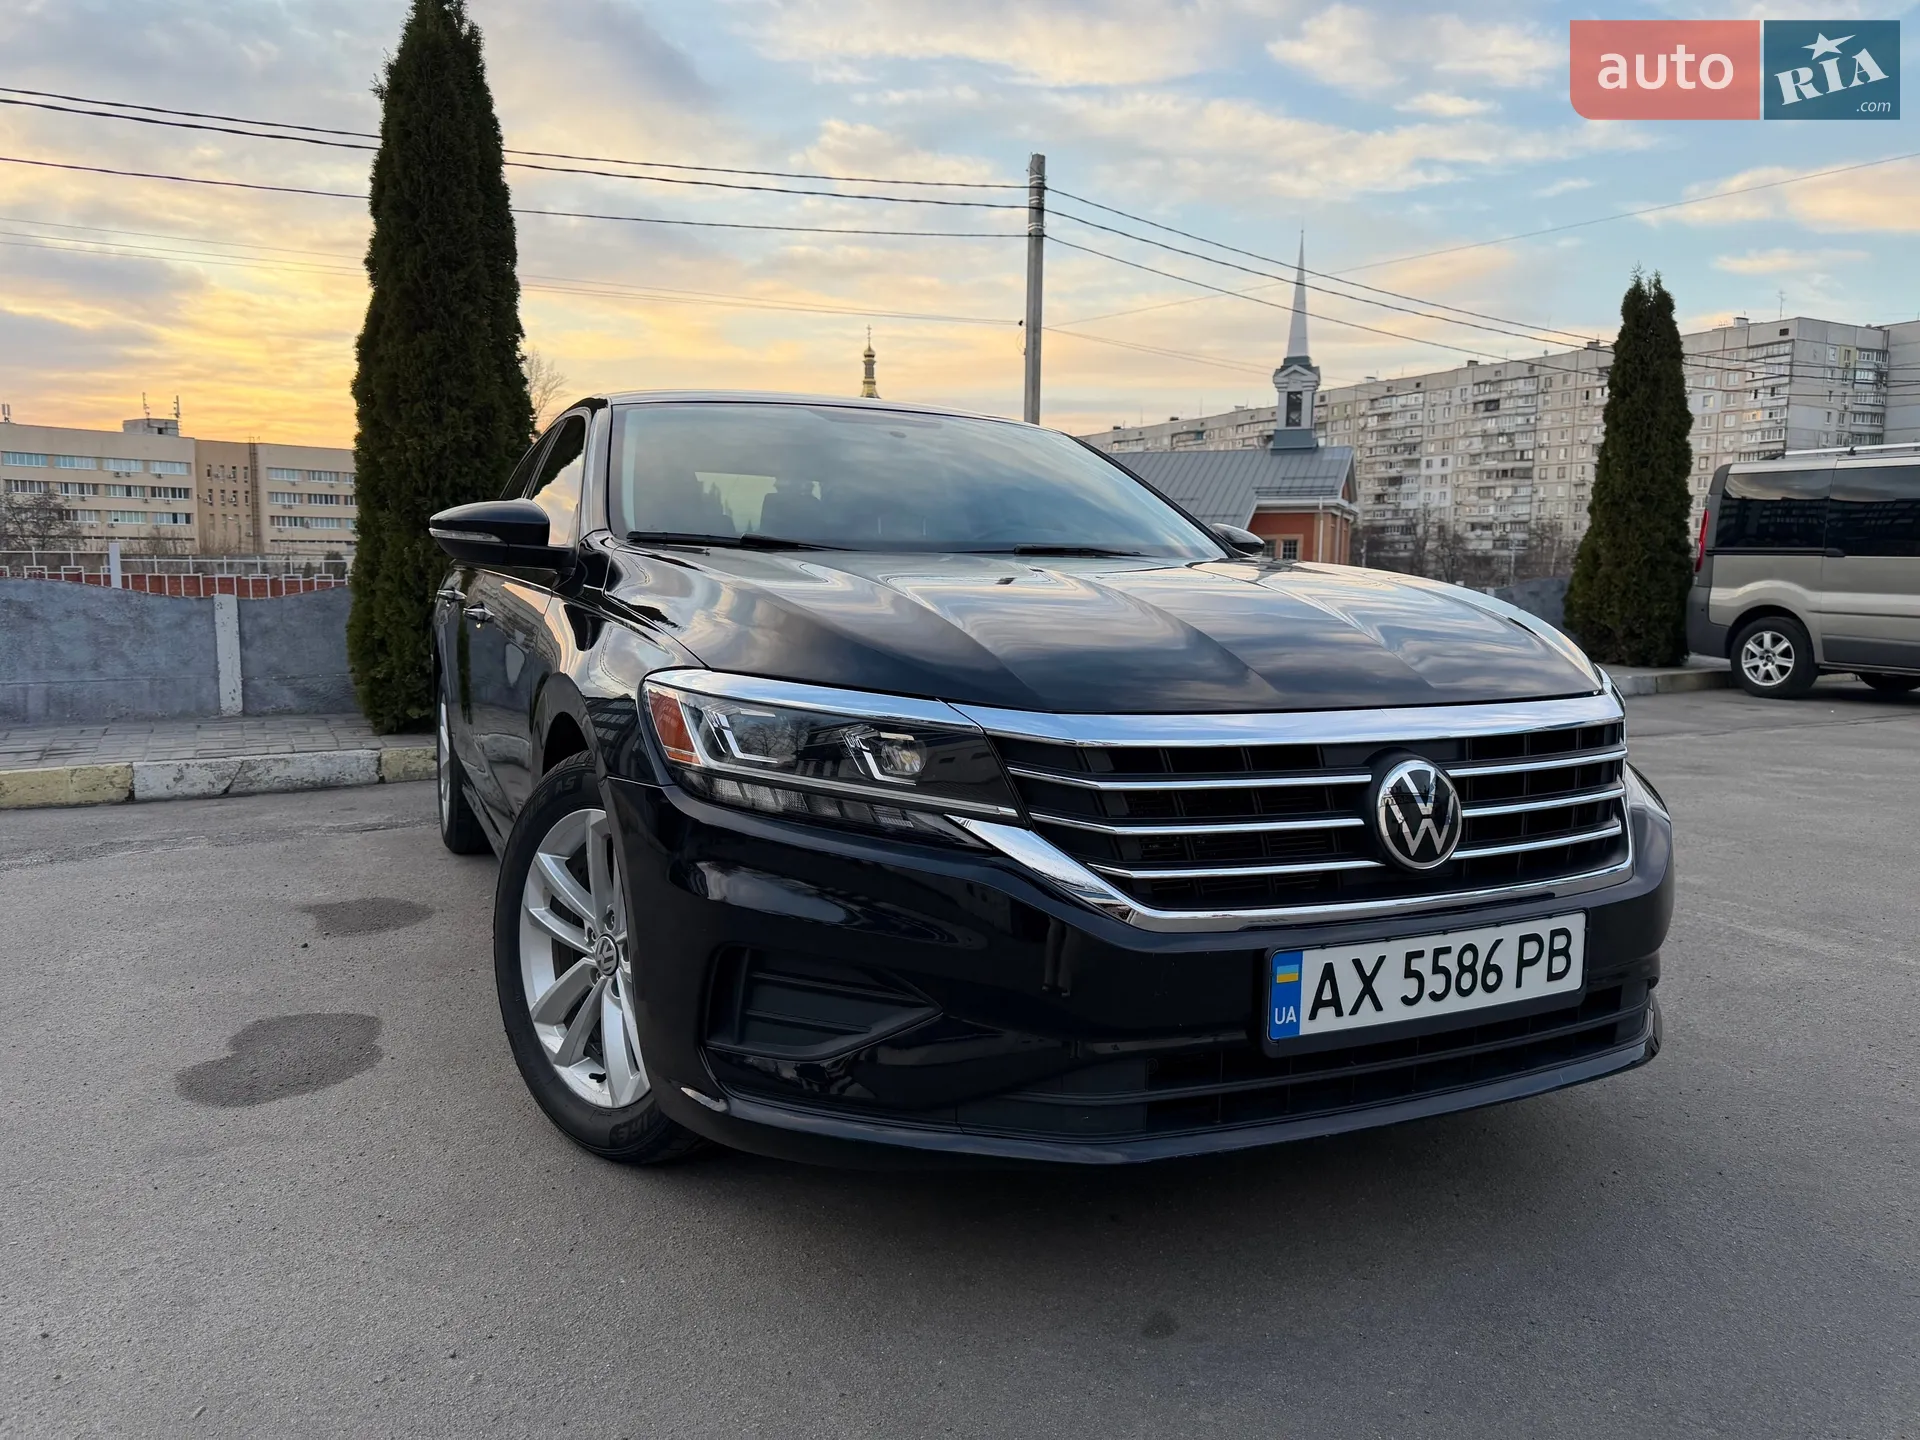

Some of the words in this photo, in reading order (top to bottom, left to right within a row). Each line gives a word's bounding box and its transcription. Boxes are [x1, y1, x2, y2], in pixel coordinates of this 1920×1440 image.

[1381, 763, 1458, 865] VW
[1274, 1006, 1297, 1026] UA
[1308, 954, 1387, 1021] AX
[1400, 938, 1504, 1007] 5586
[1515, 927, 1572, 989] PB
